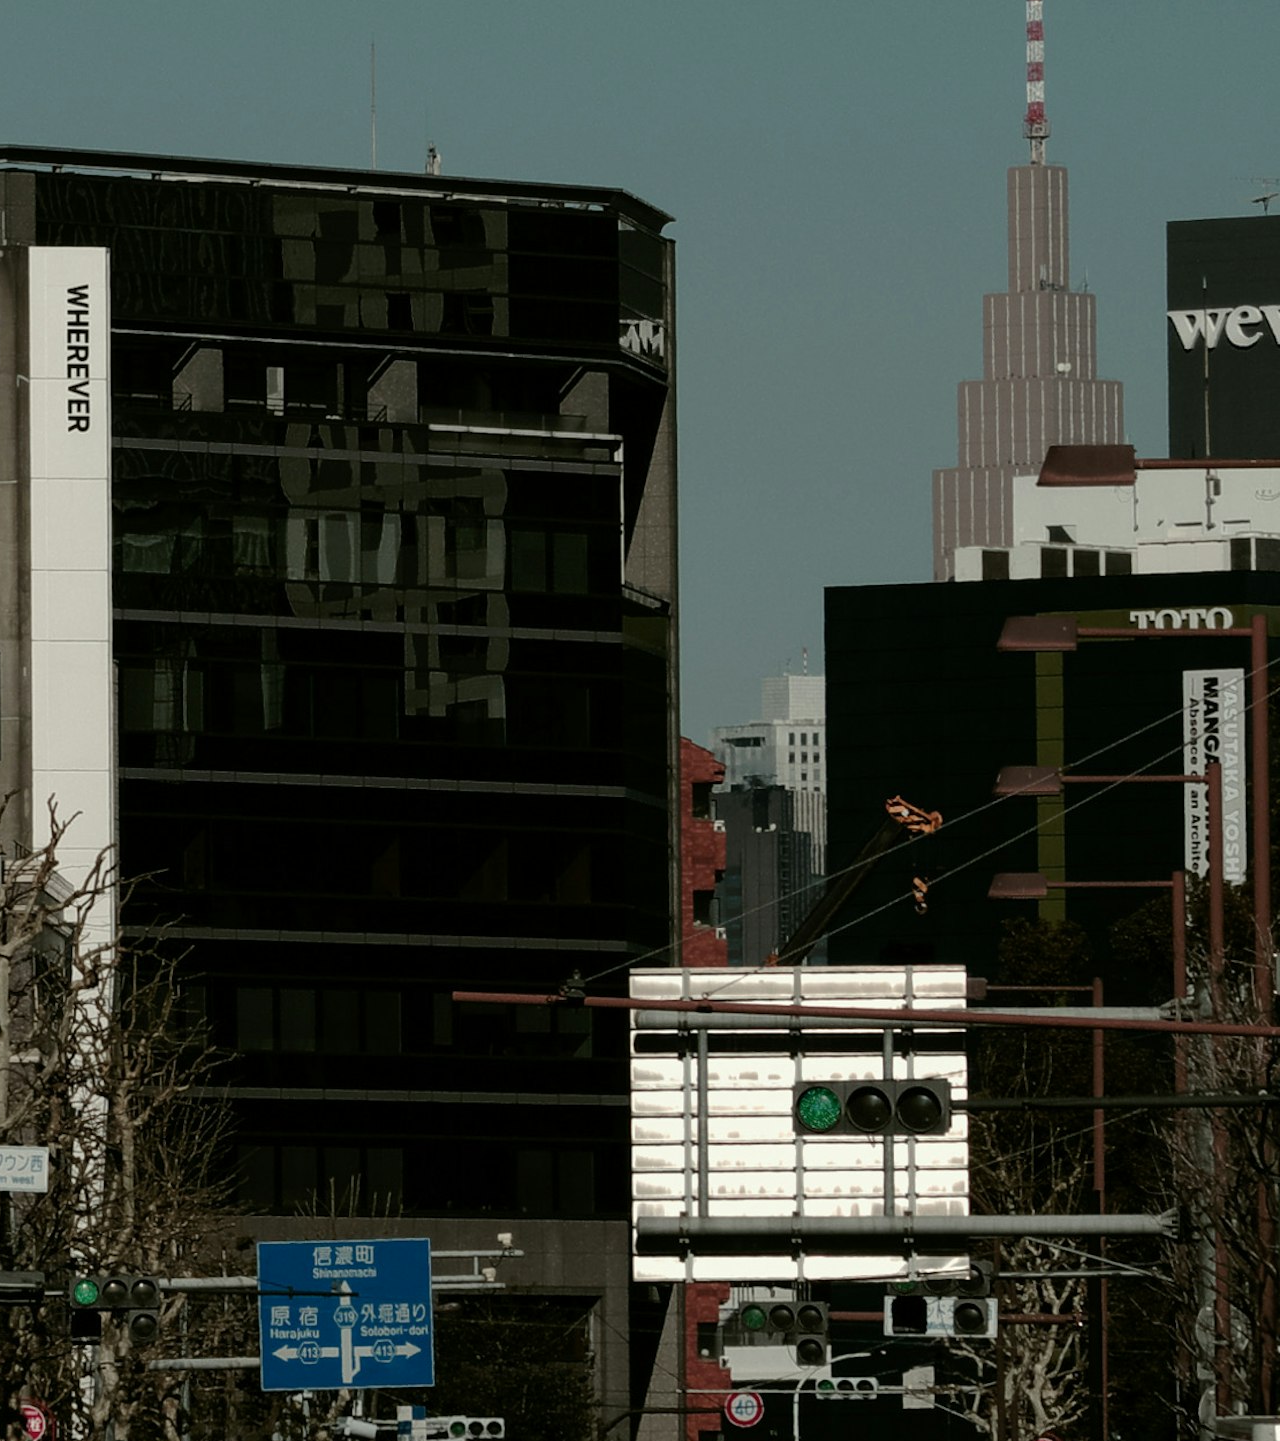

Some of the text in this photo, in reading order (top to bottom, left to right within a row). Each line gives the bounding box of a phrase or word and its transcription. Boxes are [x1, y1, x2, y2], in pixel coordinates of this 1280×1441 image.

[67, 284, 90, 432] WHEREVER
[312, 1244, 375, 1267] 信濃町
[312, 1267, 378, 1280] Shinanomachi
[270, 1302, 427, 1328] 原宿 外堀通り
[270, 1327, 320, 1341] Harajuku
[300, 1343, 392, 1360] 413 413
